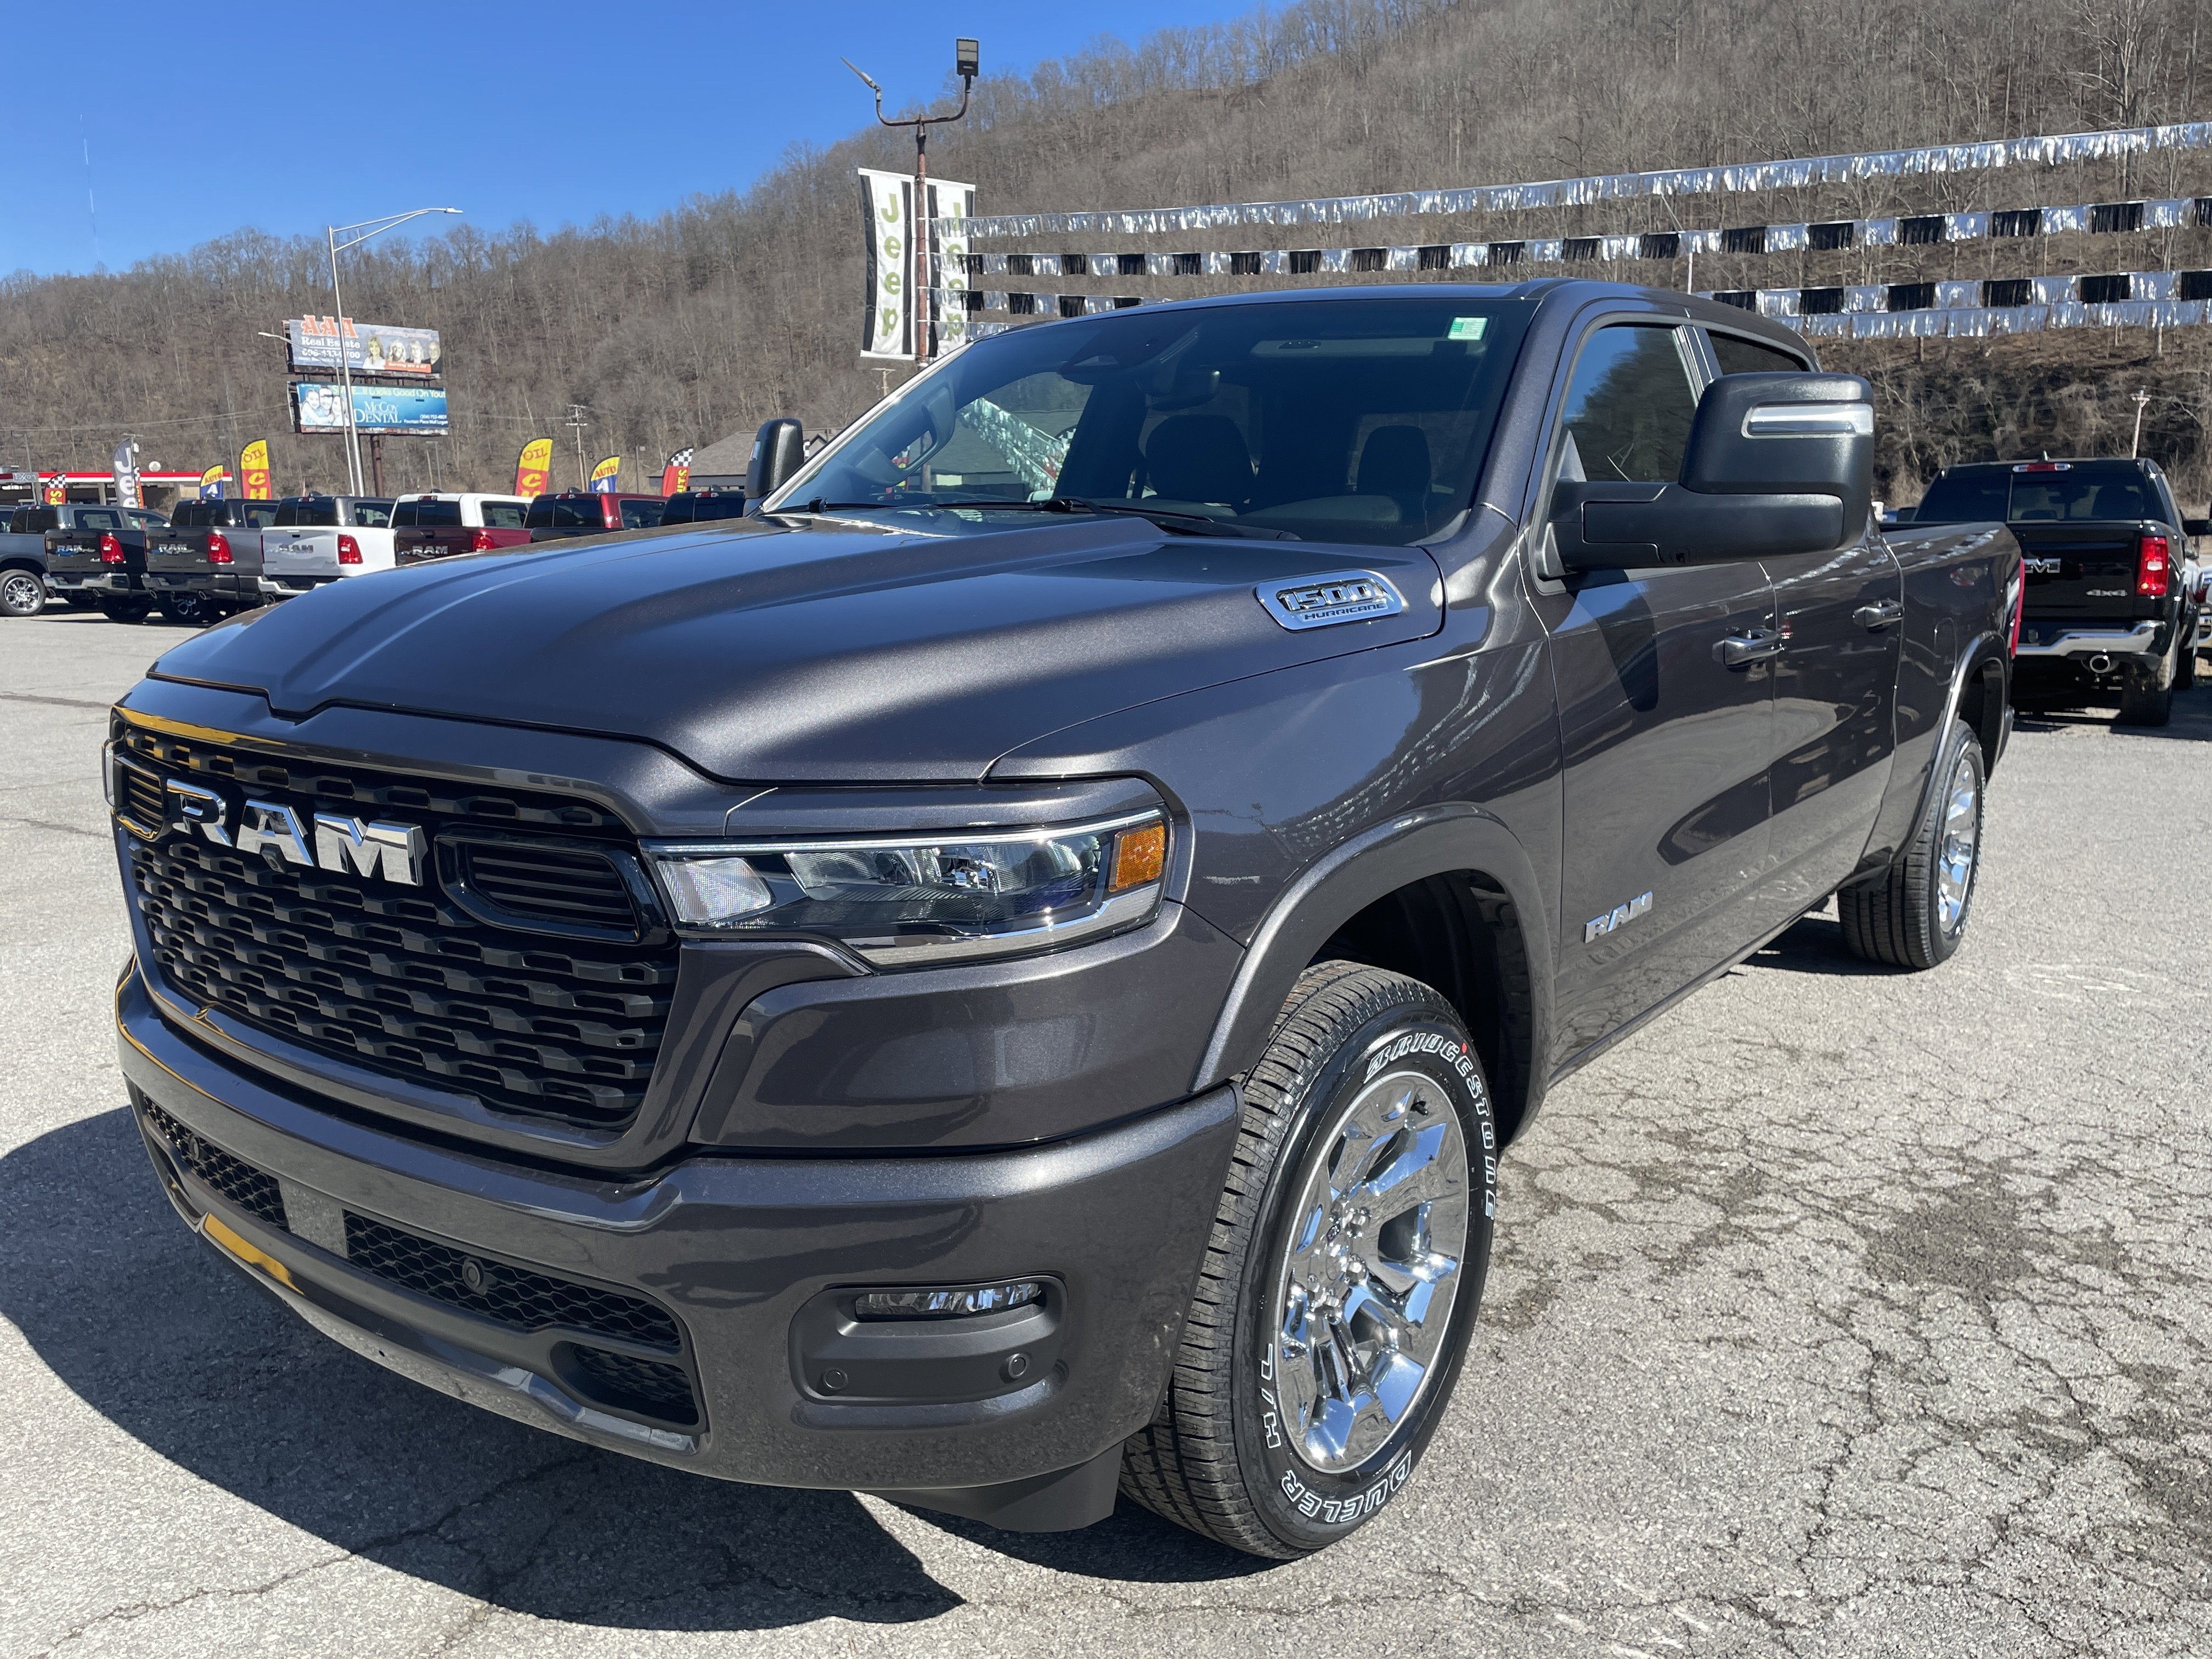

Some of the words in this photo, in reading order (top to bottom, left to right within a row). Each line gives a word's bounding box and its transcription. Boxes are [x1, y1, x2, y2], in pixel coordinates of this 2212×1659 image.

[881, 193, 901, 336] Jeep
[301, 314, 359, 338] AAA
[301, 336, 325, 346] Real
[326, 337, 360, 349] Esate
[393, 387, 416, 397] Good
[416, 388, 429, 398] On
[243, 448, 266, 463] OIL
[522, 447, 549, 461] OIL
[204, 472, 223, 484] AUTO
[594, 466, 616, 479] AUTO
[412, 545, 448, 555] RAM
[1279, 582, 1376, 611] 1500
[2085, 588, 2128, 597] 4x4
[1305, 603, 1386, 620] HURRICANE
[166, 778, 428, 887] RAM
[1583, 890, 1653, 944] RAM
[1363, 1032, 1497, 1221] BRIDGESTONE
[1281, 1449, 1412, 1523] DUELER
